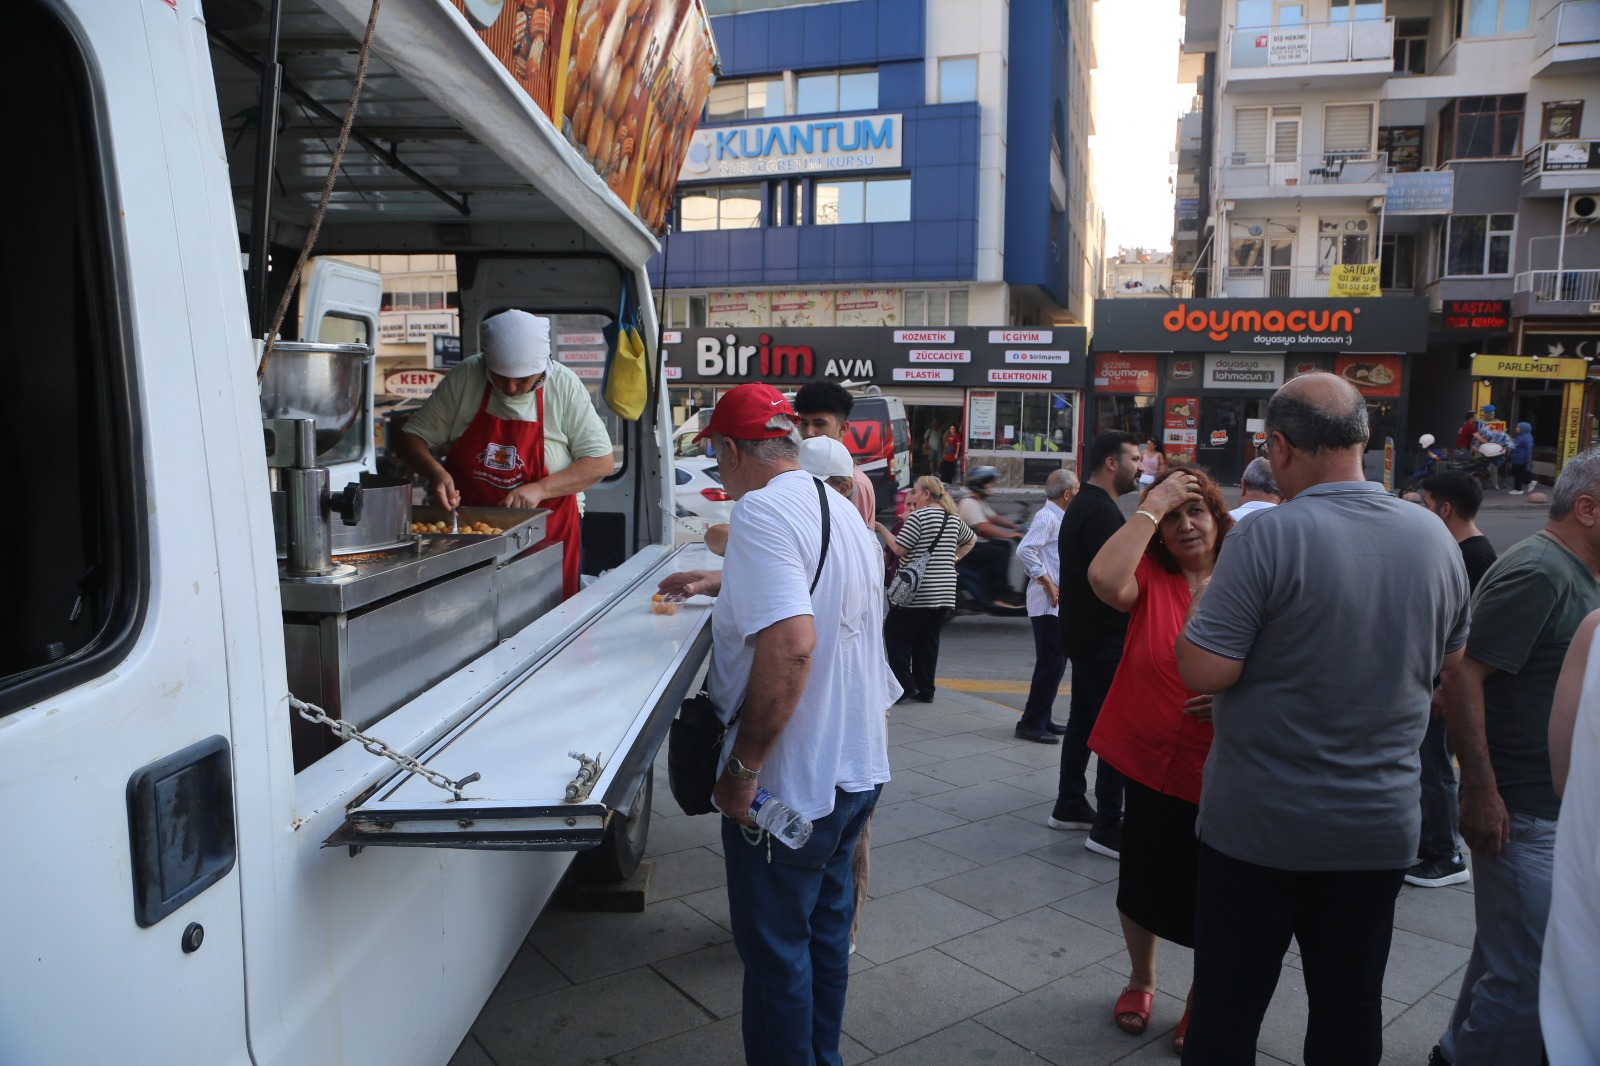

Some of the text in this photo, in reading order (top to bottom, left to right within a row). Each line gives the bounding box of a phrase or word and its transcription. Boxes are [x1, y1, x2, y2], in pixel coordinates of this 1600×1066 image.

[716, 118, 893, 160] KUANTUM
[826, 153, 874, 168] KURSU
[1343, 264, 1376, 275] SATILIK
[1163, 304, 1353, 342] doymacun
[902, 332, 946, 341] KOZMETİK
[1002, 333, 1039, 342] İÇ GİYİM
[1298, 335, 1343, 344] lahmacun
[697, 333, 814, 377] Birim
[916, 350, 964, 360] ZÜCCACİYE
[824, 359, 874, 377] AVM
[1498, 361, 1561, 373] PARLEMENT
[905, 369, 941, 379] PLASTİK
[991, 370, 1048, 380] ELEKTRONİK
[1101, 366, 1149, 380] doymaya
[1215, 371, 1263, 380] lahmacun
[400, 373, 436, 385] KENT
